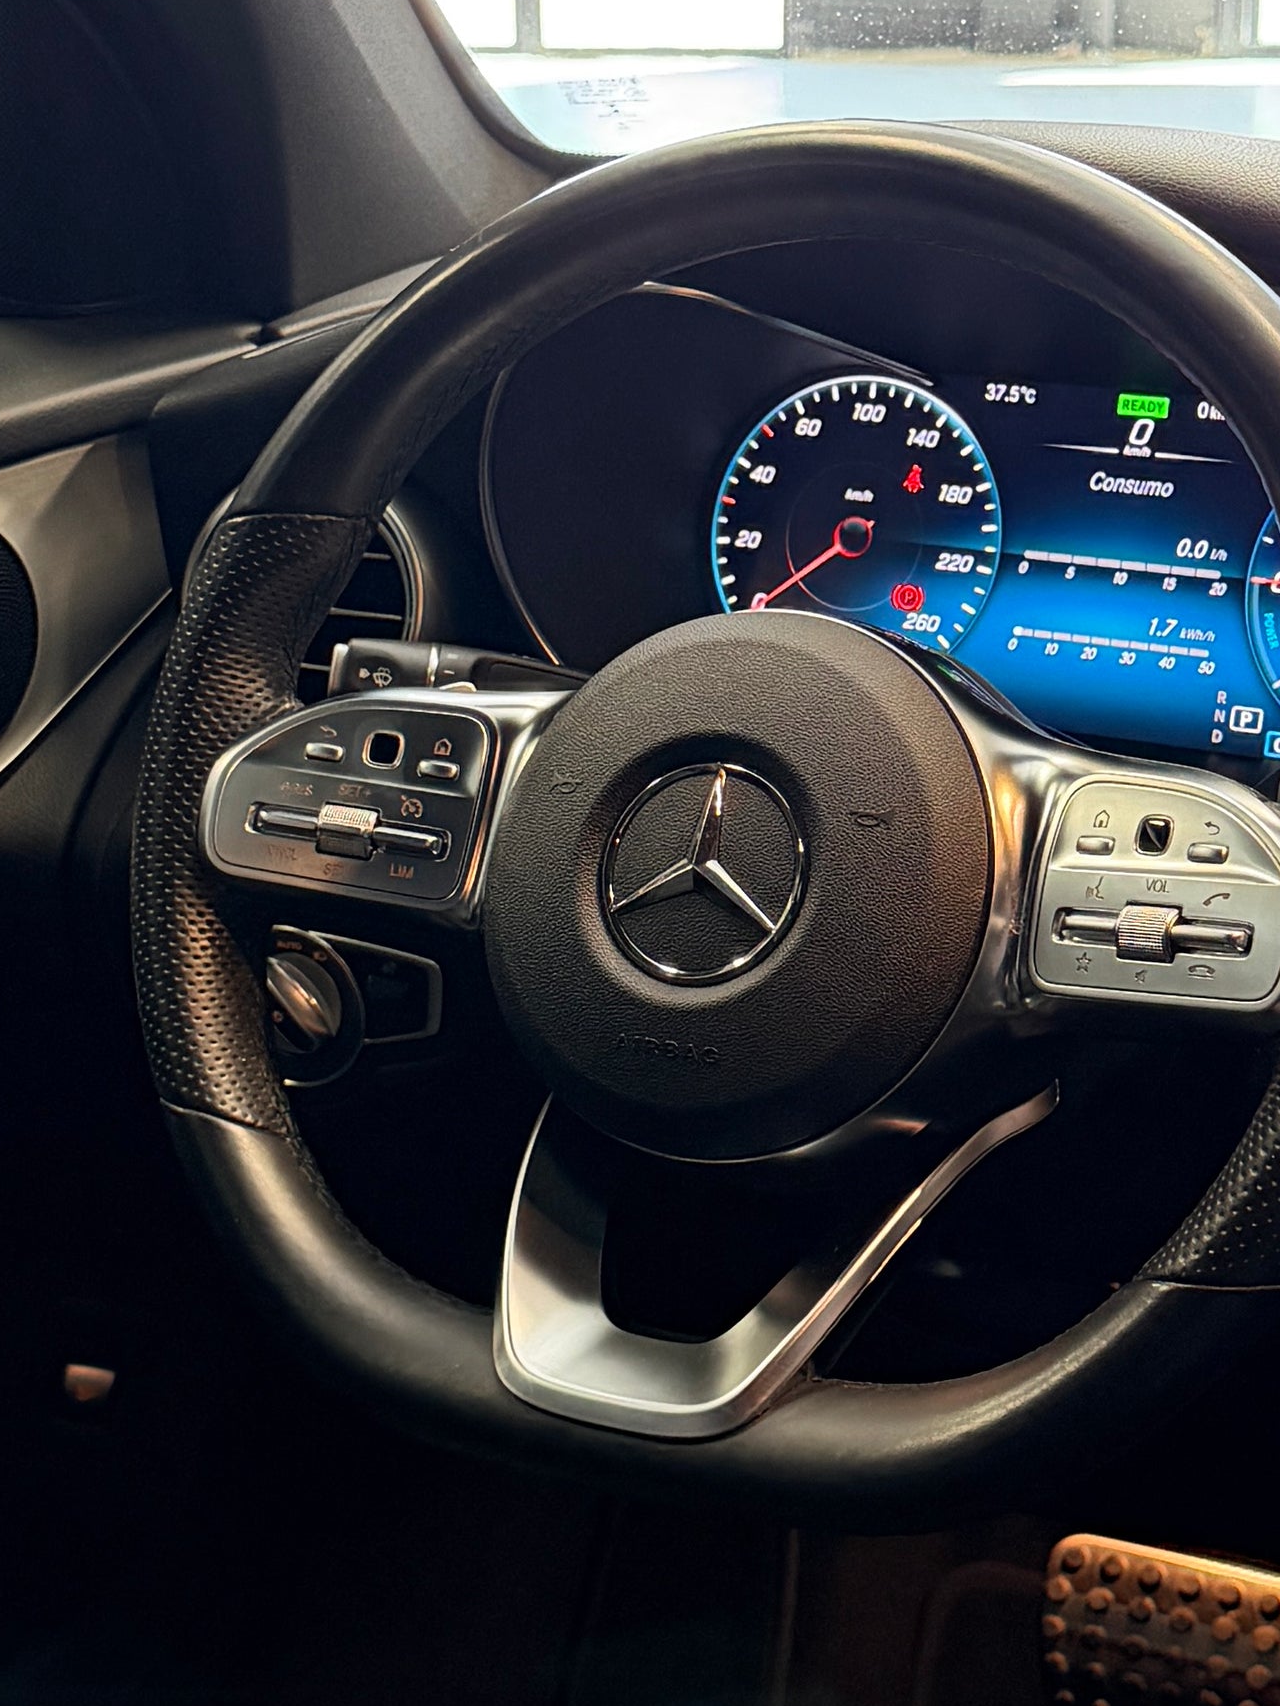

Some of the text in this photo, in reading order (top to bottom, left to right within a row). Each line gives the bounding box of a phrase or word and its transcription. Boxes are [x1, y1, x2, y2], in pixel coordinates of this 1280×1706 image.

[984, 383, 1037, 404] 37.5°C
[852, 402, 886, 423] 100
[1121, 399, 1166, 414] READY
[794, 418, 823, 437] 60
[906, 427, 940, 449] 140
[1128, 418, 1155, 446] 0
[749, 465, 776, 484] 40
[1089, 471, 1174, 498] Consumo
[937, 484, 973, 505] 180
[734, 530, 762, 549] 20
[1176, 538, 1209, 560] 0.0
[934, 552, 975, 573] 220
[1018, 561, 1228, 597] 0 5 10 15 20
[902, 613, 941, 633] 260
[1149, 617, 1178, 638] 1.7
[1263, 612, 1280, 650] POWER
[1007, 637, 1216, 676] 0 10 20 30 40 50
[1216, 690, 1228, 705] R
[1214, 709, 1226, 724] N
[1210, 729, 1223, 744] D
[389, 862, 415, 879] LIM
[1145, 879, 1170, 893] VOL
[619, 1032, 721, 1064] AIRBAG
